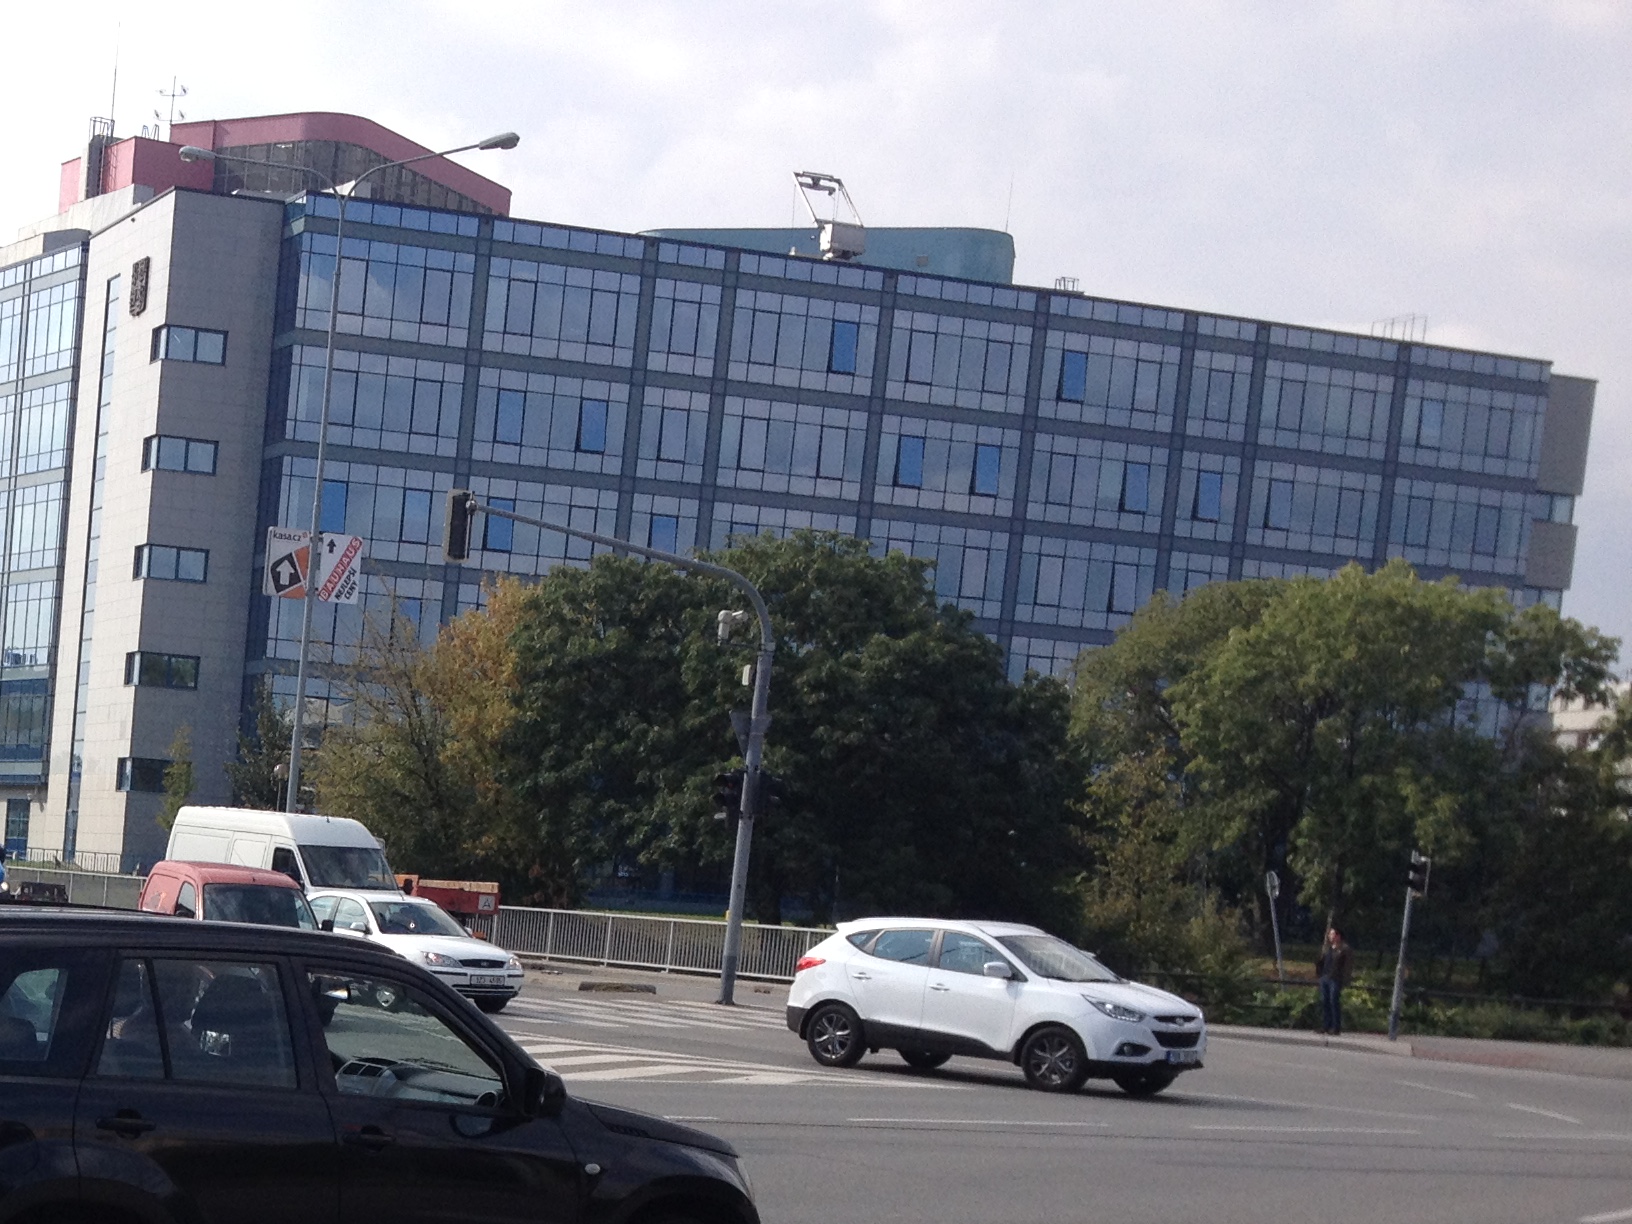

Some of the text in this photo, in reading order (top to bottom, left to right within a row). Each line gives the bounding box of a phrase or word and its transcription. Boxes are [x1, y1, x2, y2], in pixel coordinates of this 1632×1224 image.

[319, 537, 362, 601] BAUHAUS
[344, 581, 359, 600] CENY
[482, 898, 492, 909] A
